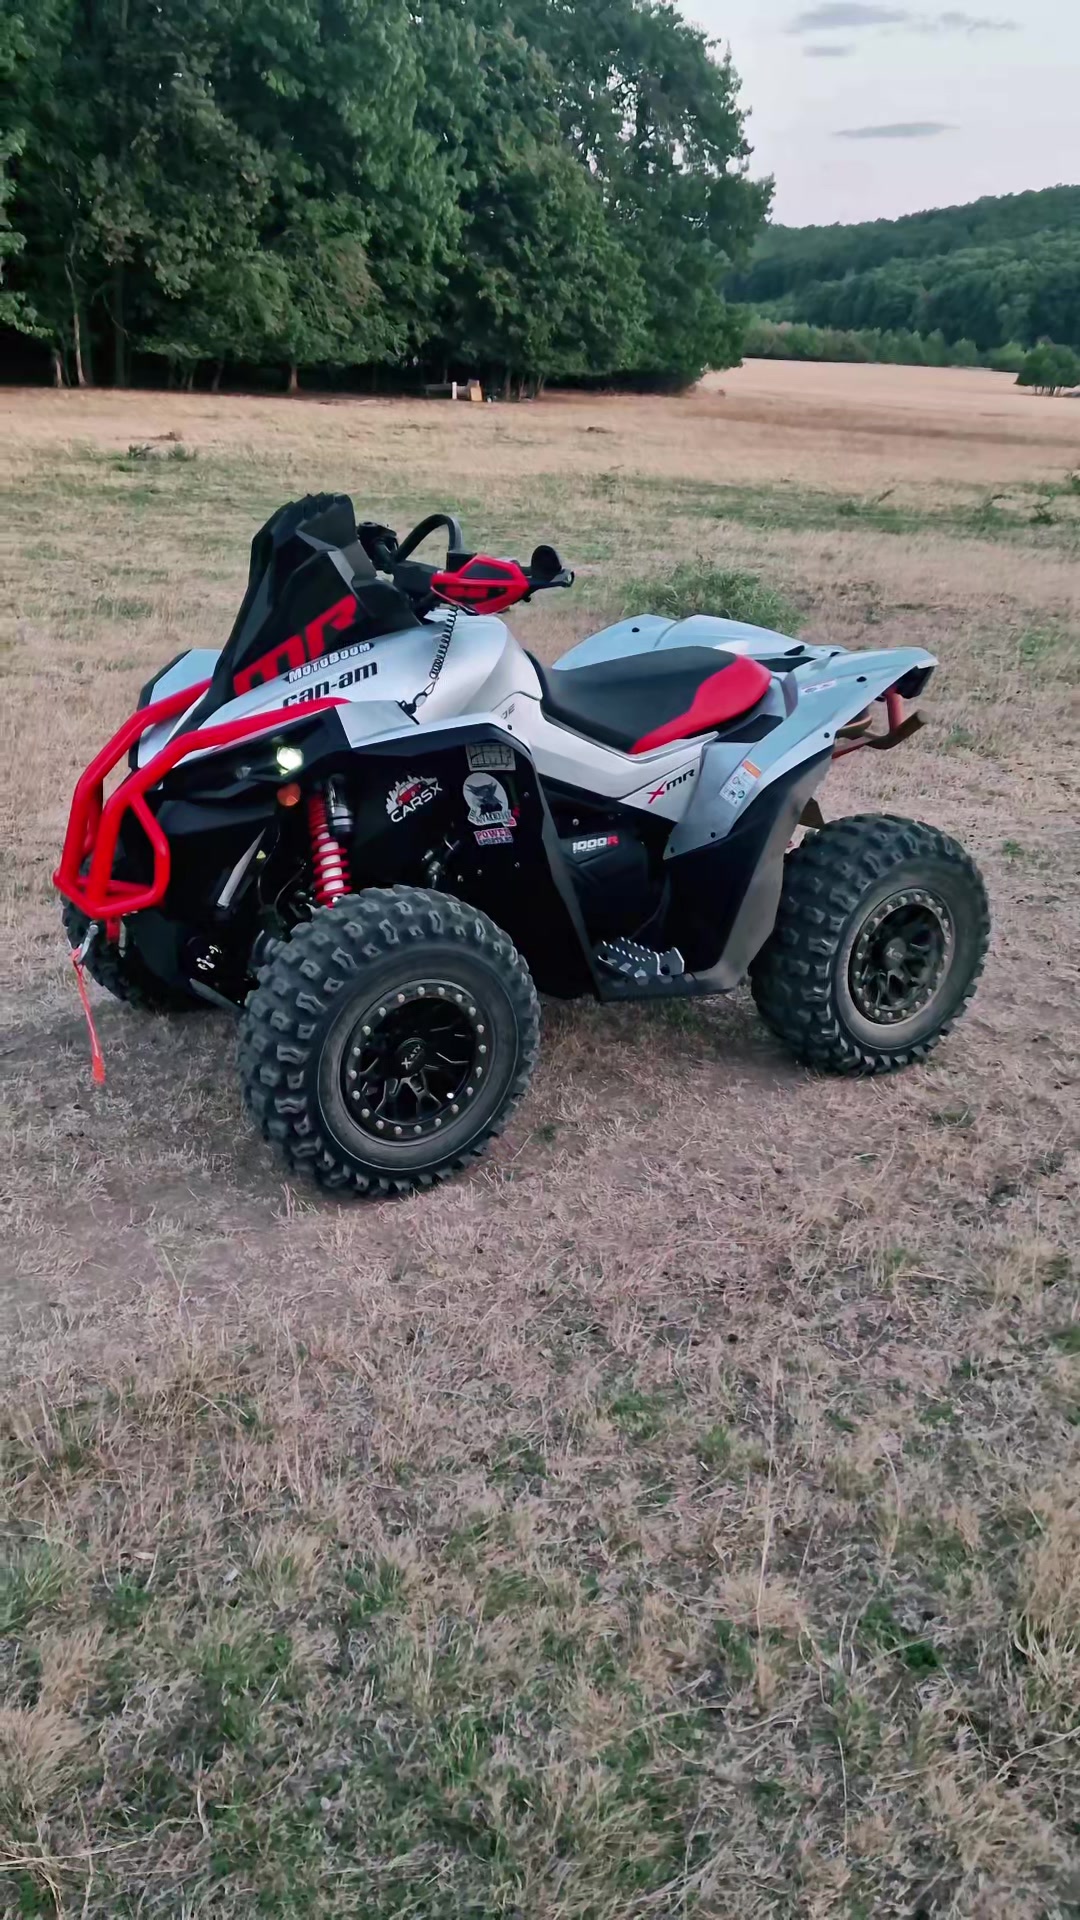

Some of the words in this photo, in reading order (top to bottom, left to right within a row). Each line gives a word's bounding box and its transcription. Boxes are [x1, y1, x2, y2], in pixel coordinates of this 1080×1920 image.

[283, 662, 378, 707] can-am
[391, 781, 443, 823] CARSX
[476, 829, 511, 840] POWER
[572, 835, 619, 853] 1000R
